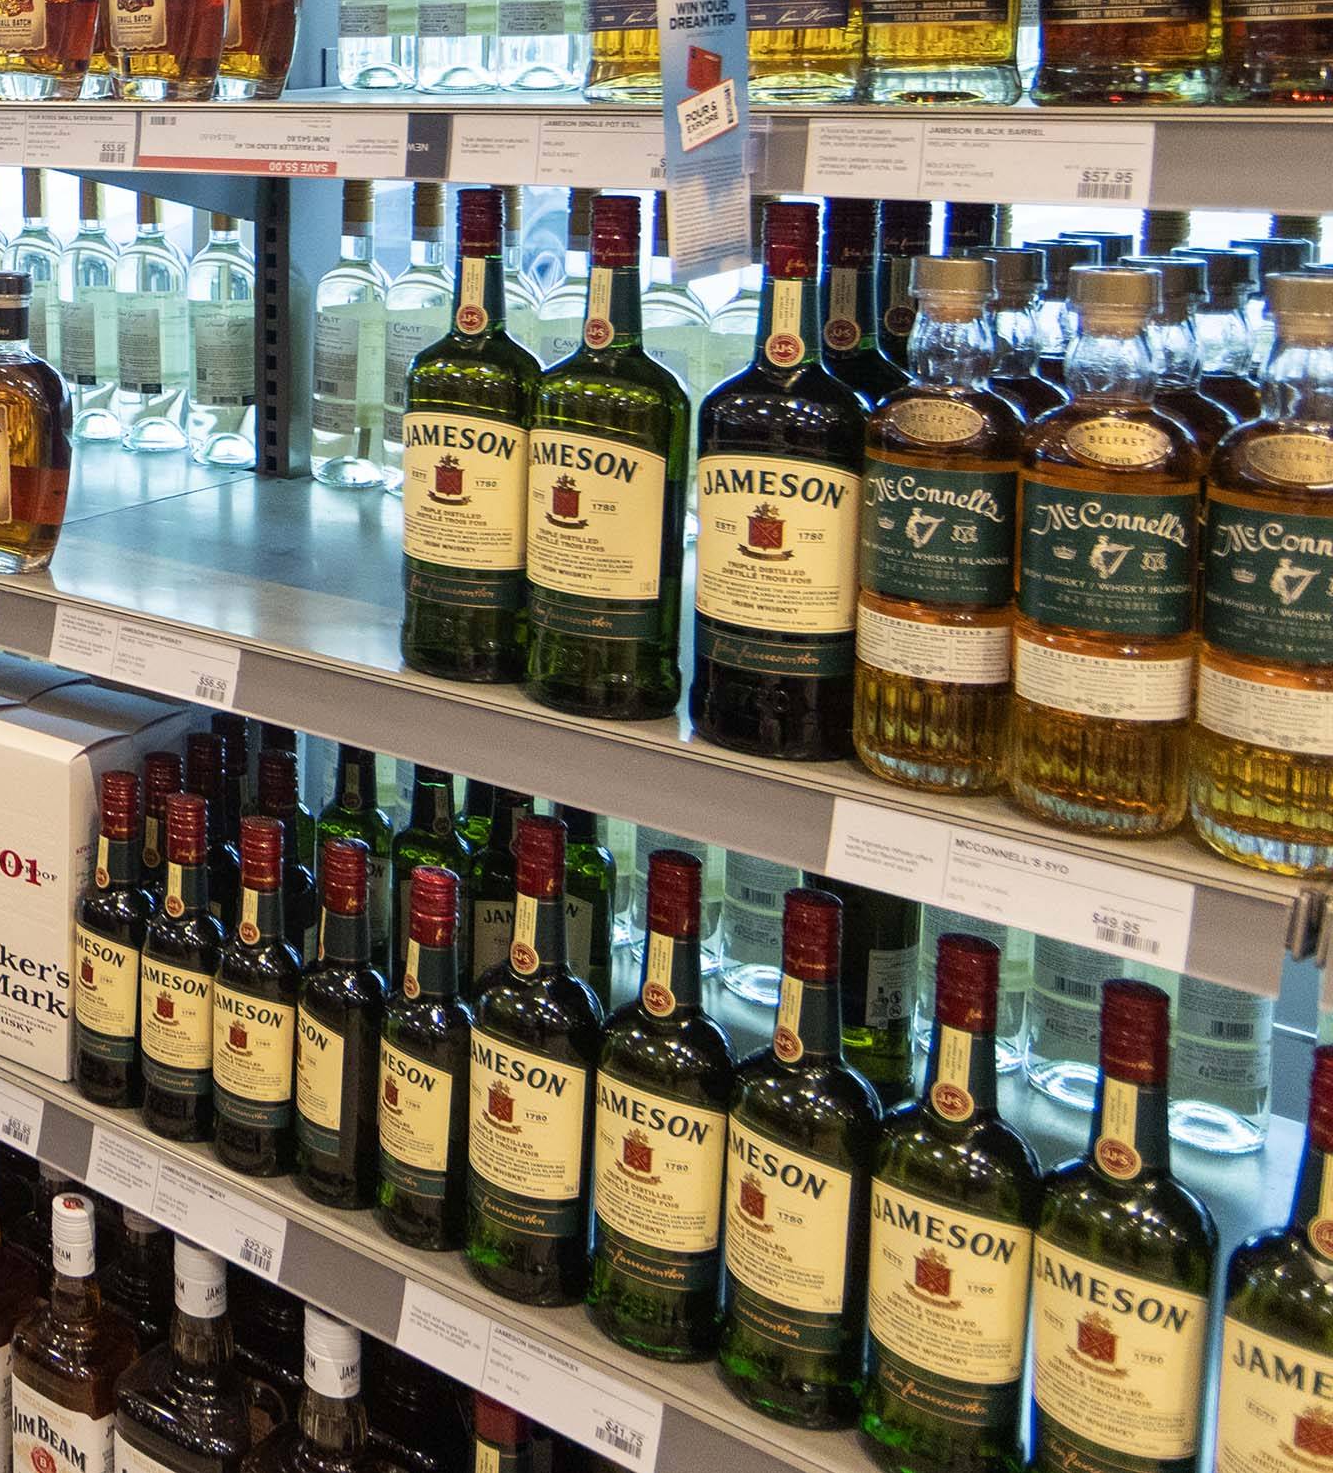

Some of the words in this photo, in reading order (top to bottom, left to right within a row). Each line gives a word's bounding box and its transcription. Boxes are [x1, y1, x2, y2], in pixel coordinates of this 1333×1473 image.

[676, 1, 699, 16] WIN
[700, 0, 730, 14] YOUR
[669, 15, 710, 30] DREAM
[711, 13, 737, 27] TRIP
[685, 105, 709, 125] POUR
[407, 142, 429, 152] NEW
[300, 162, 328, 173] SAVE
[1082, 169, 1134, 185] $57.95
[405, 424, 516, 461] JAMESON
[1088, 433, 1147, 448] BELFAST
[703, 469, 846, 509] JAMESON
[865, 475, 1006, 524] McConnell's
[1030, 501, 1189, 547] McConnell's
[798, 532, 823, 541] 1780
[954, 837, 1043, 868] MCCONNELL'S
[1091, 911, 1141, 935] $49.95
[873, 1192, 1018, 1266] JAMESON
[243, 1237, 274, 1261] $22.95
[1035, 1250, 1190, 1335] JAMESON
[13, 1405, 36, 1436] JIM
[37, 1414, 87, 1473] BEAM
[604, 1419, 645, 1448] $41.75
